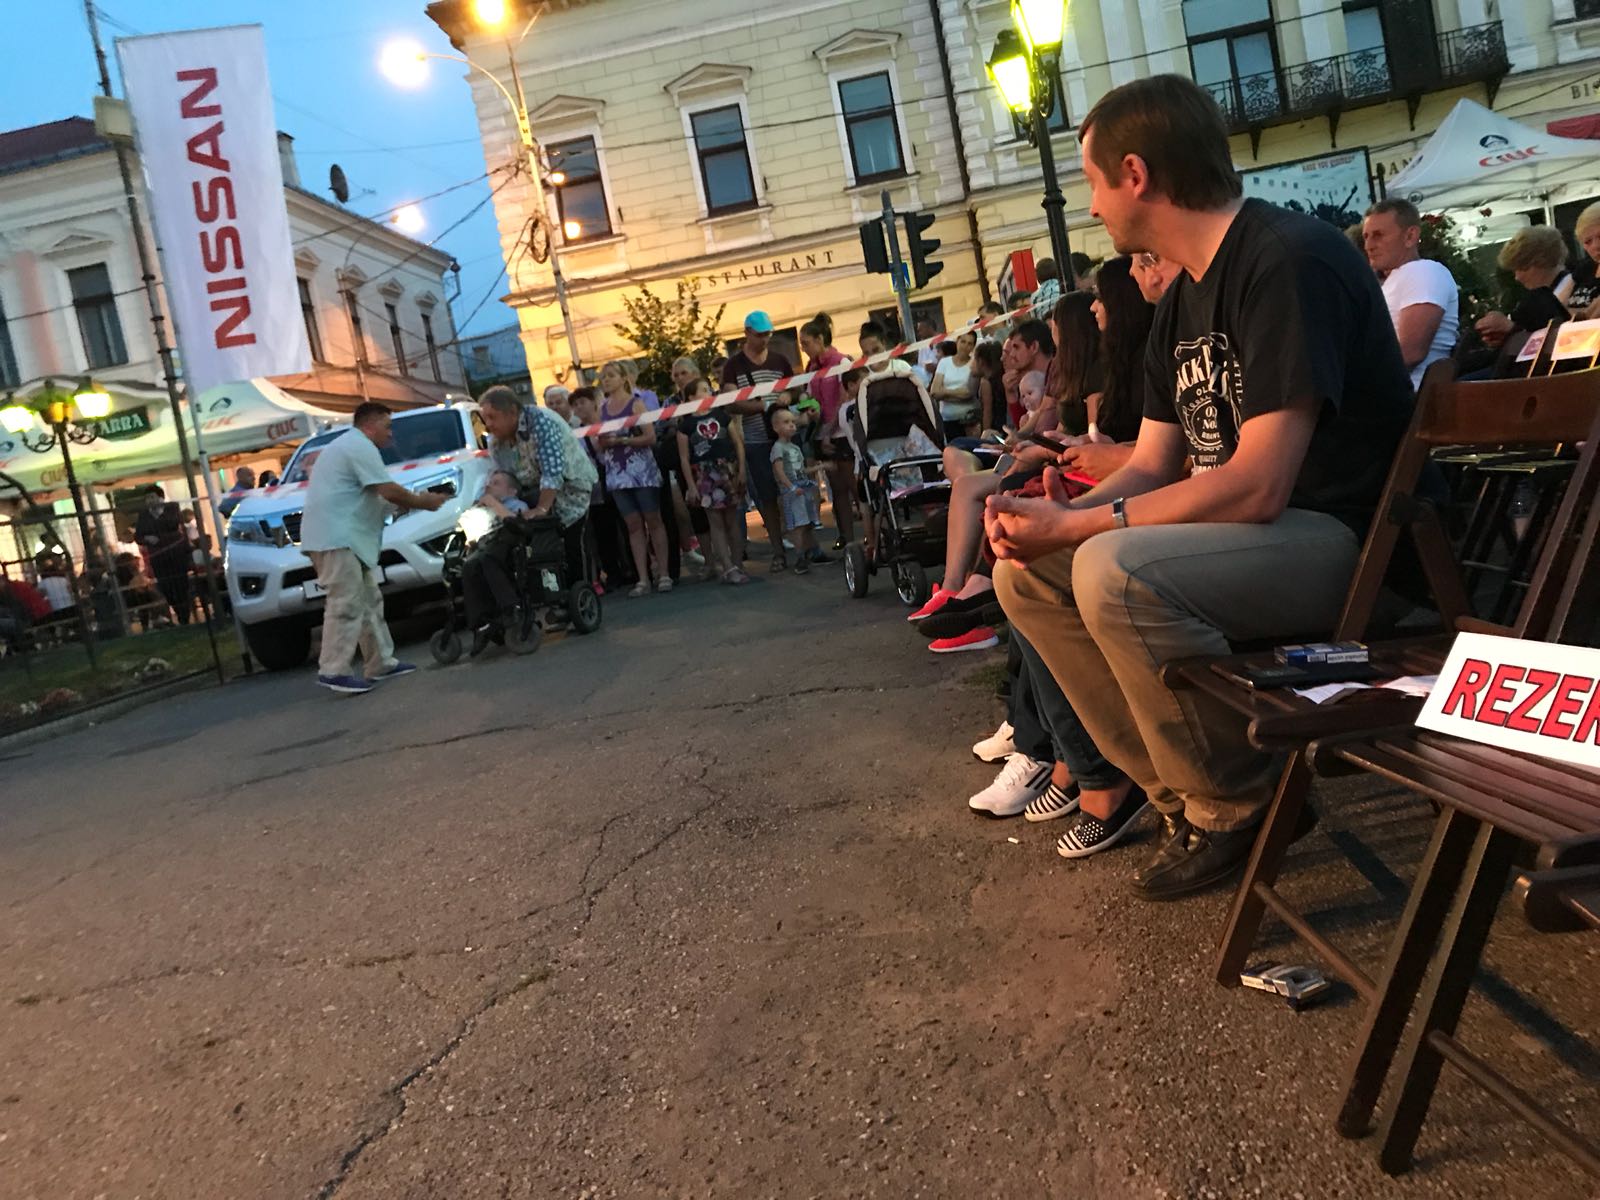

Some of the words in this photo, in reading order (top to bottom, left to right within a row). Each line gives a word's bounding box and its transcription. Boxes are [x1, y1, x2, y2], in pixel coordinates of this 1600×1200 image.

[176, 67, 257, 349] NISSAN
[1176, 356, 1206, 402] ACK
[266, 417, 298, 440] CIUC
